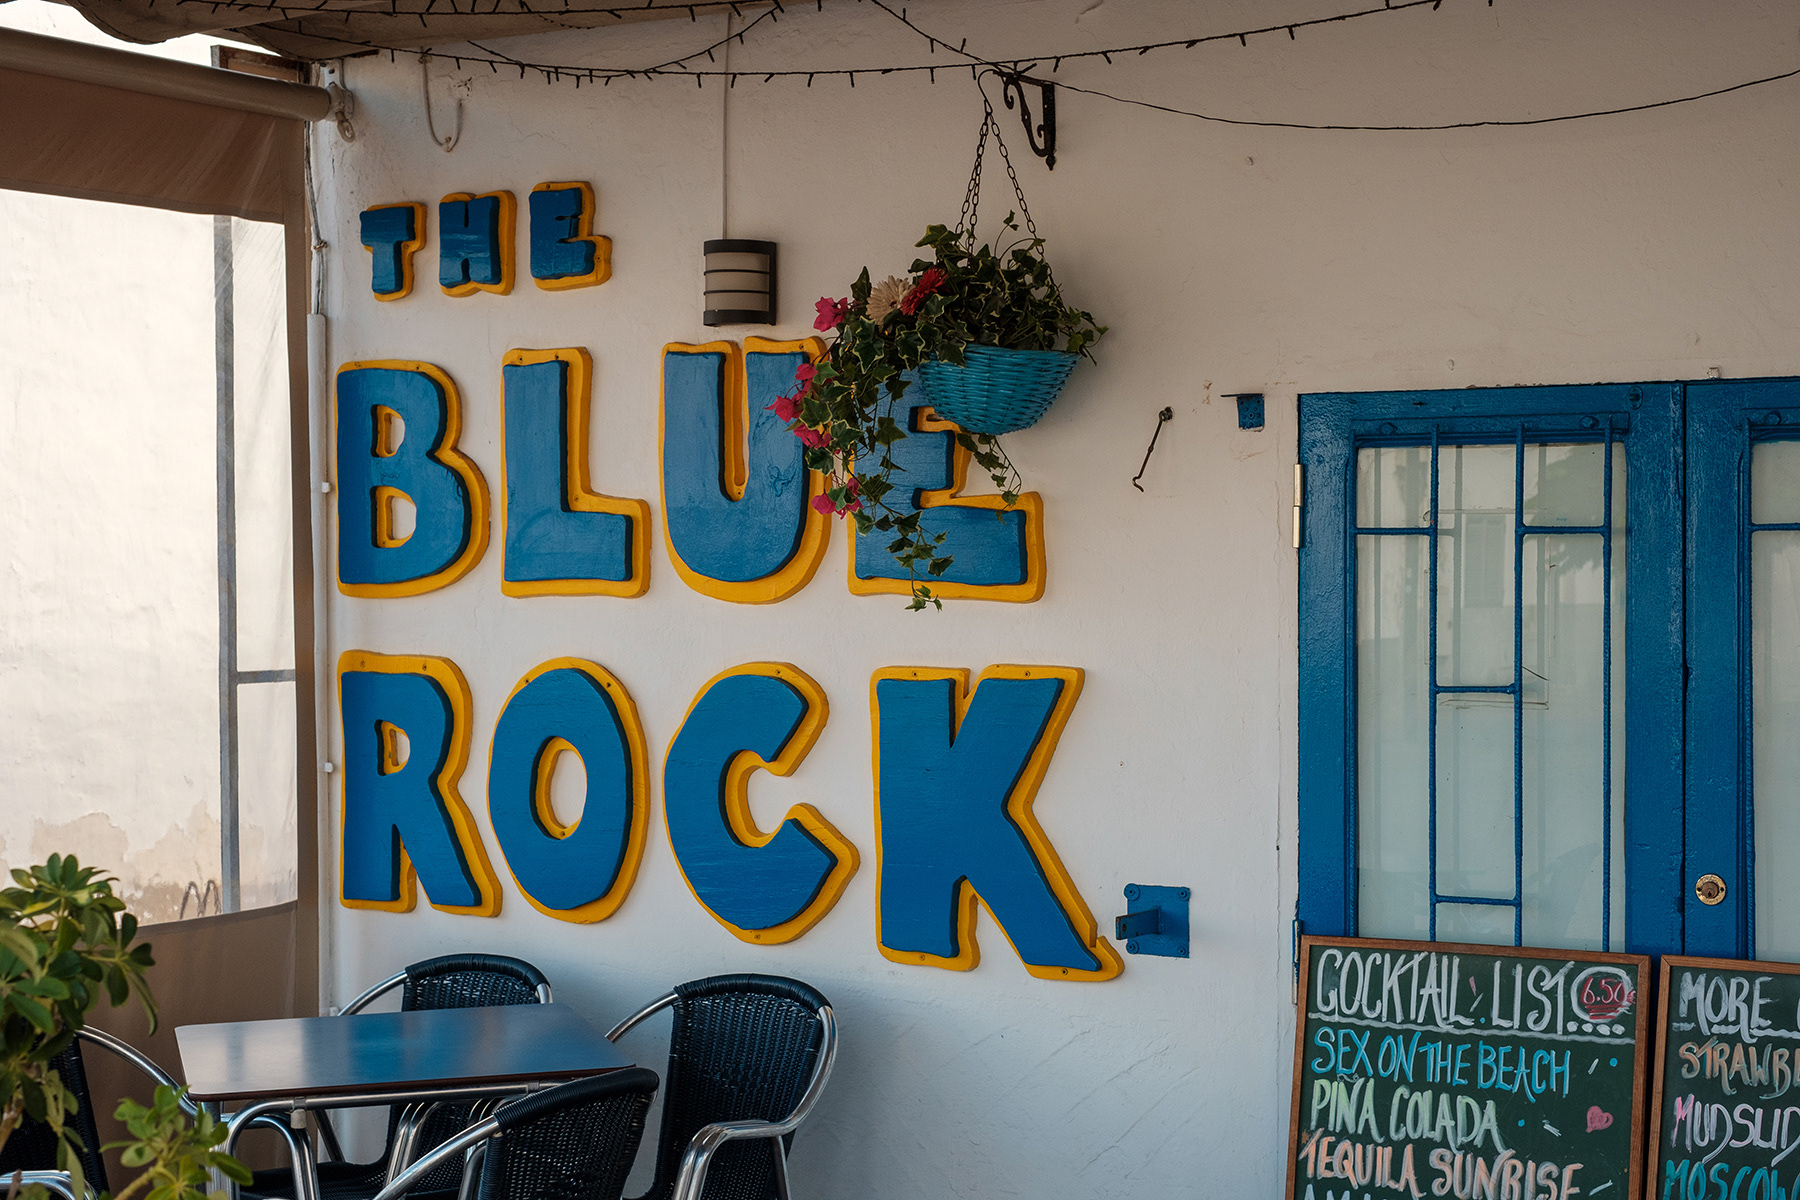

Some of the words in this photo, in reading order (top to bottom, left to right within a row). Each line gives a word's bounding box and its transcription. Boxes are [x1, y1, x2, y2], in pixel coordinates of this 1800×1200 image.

[360, 180, 612, 302] THE
[336, 336, 1046, 604] BLUE
[337, 650, 1124, 982] ROCK
[1678, 971, 1774, 1044] MORE
[1310, 1026, 1373, 1077] SEX
[1378, 1031, 1421, 1083] ON
[1418, 1040, 1472, 1087] THE
[1477, 1039, 1571, 1103] BEACH
[1678, 1035, 1800, 1100] STRAWB
[1310, 1073, 1385, 1144] PIÑA
[1389, 1084, 1510, 1154] COLADA
[1298, 1127, 1427, 1200] TEQUILA
